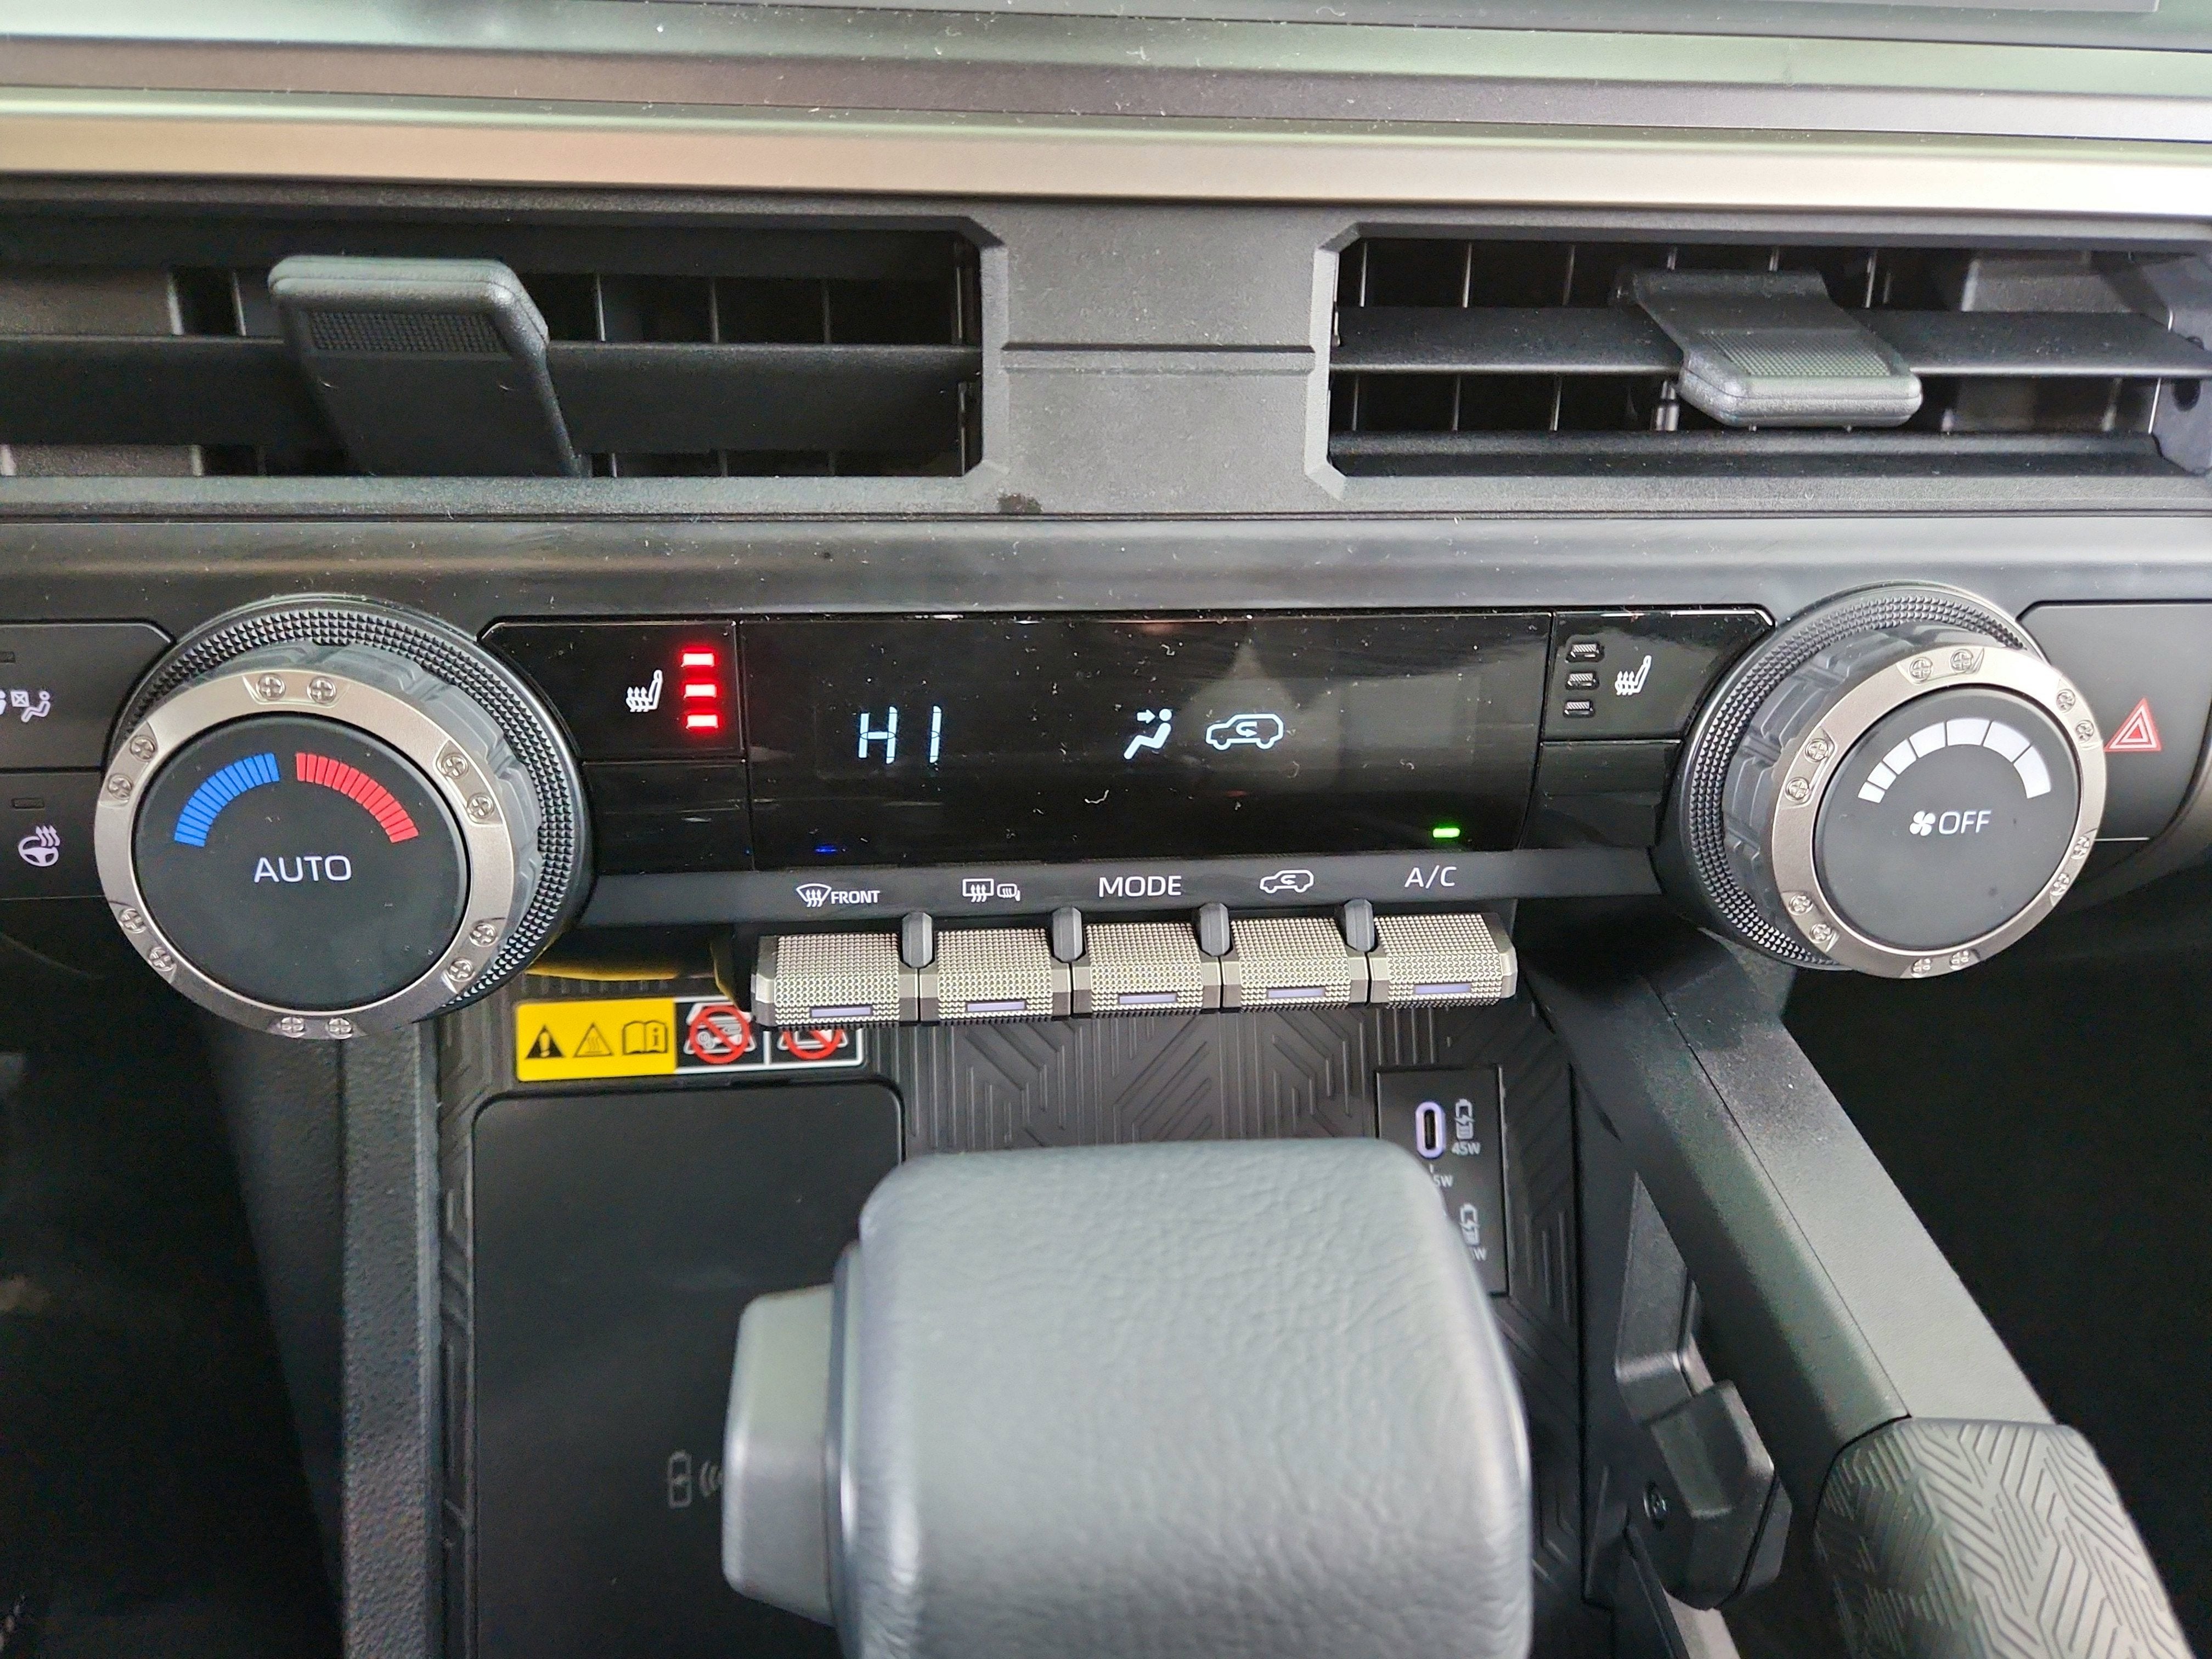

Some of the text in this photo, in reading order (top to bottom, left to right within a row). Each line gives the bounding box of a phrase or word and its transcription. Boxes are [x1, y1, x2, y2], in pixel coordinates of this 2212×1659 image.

[857, 706, 942, 764] HI
[1939, 809, 1991, 835] OFF
[253, 855, 352, 883] AUTO
[1404, 865, 1457, 889] A/C
[831, 889, 881, 905] FRONT
[1098, 874, 1182, 898] MODE
[1451, 1141, 1481, 1156] 45W
[1433, 1173, 1454, 1188] 5W
